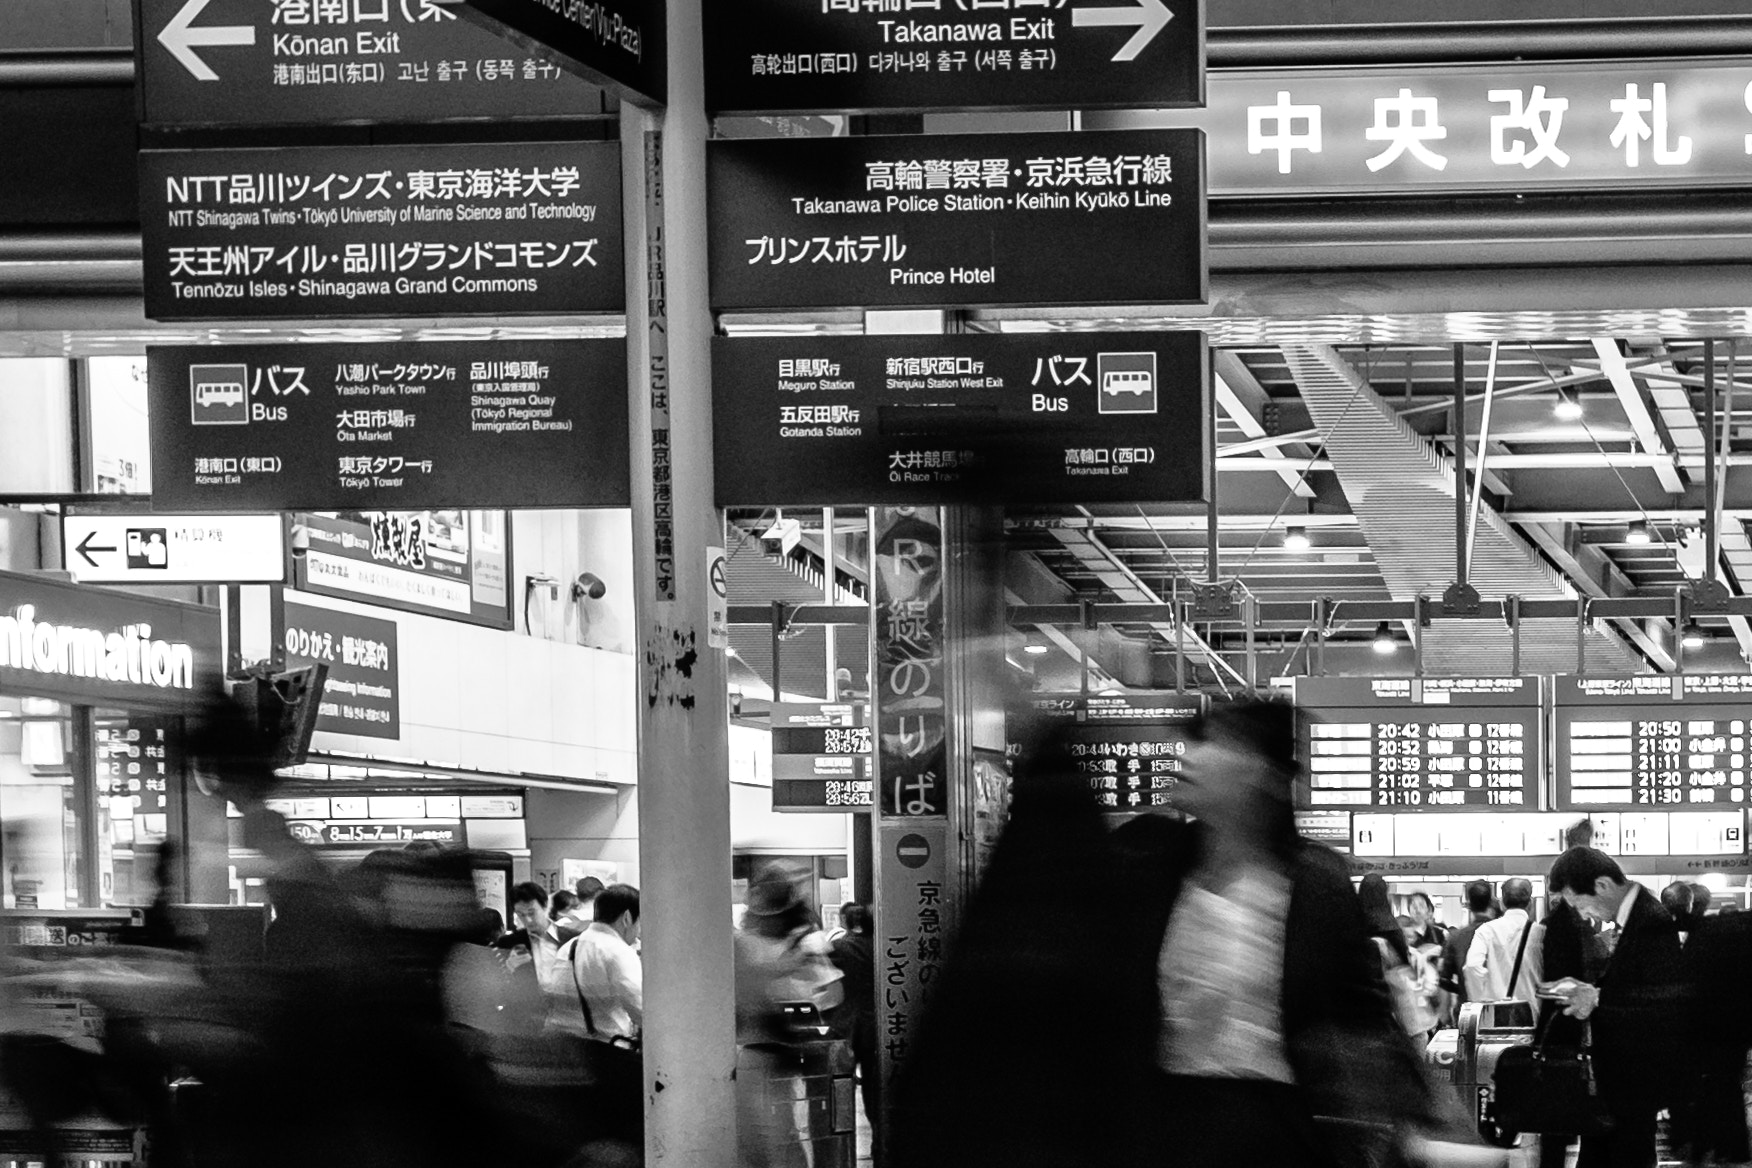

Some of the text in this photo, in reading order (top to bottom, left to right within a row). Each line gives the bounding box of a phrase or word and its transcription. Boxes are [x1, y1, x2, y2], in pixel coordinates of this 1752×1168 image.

[878, 18, 1054, 42] Takanawa Exit
[274, 32, 400, 55] Kōnan Exit
[436, 59, 468, 81] 출구
[869, 51, 931, 73] 다카나와
[937, 51, 968, 72] 출구
[1246, 84, 1693, 174] 中央改札
[865, 155, 1173, 190] 高輪警察署・京浜急行線
[167, 166, 580, 204] NTT品川ツインズ・東京海洋大学
[792, 198, 882, 216] Takanawa
[886, 196, 940, 213] Police
[1074, 191, 1130, 212] Kyūkō
[1134, 191, 1172, 208] Line
[169, 211, 193, 226] NTT
[197, 209, 259, 229] Shinagawa
[341, 205, 397, 225] University
[399, 205, 411, 222] of
[414, 207, 451, 222] Marine
[456, 204, 501, 220] Science
[505, 204, 526, 219] and
[529, 202, 596, 222] Technology
[746, 235, 906, 264] プリンスホテル
[890, 267, 995, 285] Prince Hotel
[172, 281, 244, 299] Tennōzu
[395, 278, 447, 294] Grand
[451, 276, 538, 293] Commons
[335, 363, 456, 382] 八潮パークタウン行
[470, 361, 549, 380] 品川埠頭行
[778, 359, 841, 378] 目黒駅行
[886, 357, 984, 376] 新宿駅西口行
[1031, 355, 1092, 387] バス
[251, 366, 311, 396] バス
[335, 383, 426, 397] Yashio Park Town
[778, 379, 856, 392] Meguro Station
[886, 376, 1004, 390] Shinjuku Station West Exit
[471, 394, 556, 408] Shinagawa Quay
[1031, 394, 1069, 412] Bus
[252, 403, 288, 421] Bus
[336, 409, 416, 429] 大田市場行
[508, 407, 552, 420] Regional
[779, 405, 860, 424] 五反田駅行
[357, 429, 393, 441] Market
[472, 420, 530, 433] Immigration
[779, 425, 862, 439] Gotanda Station
[194, 456, 282, 473] 港南口(東口)
[338, 455, 433, 474] 東京タワー行
[373, 474, 403, 488] Tower
[904, 471, 930, 481] Race
[1378, 723, 1421, 738] 20:42
[1638, 721, 1682, 736] 20:50
[1378, 740, 1421, 755] 20:52
[1638, 737, 1682, 753] 21:00
[1378, 757, 1421, 772] 20:59
[1638, 754, 1682, 770] 21:11
[1378, 774, 1421, 789] 21:02
[1638, 771, 1682, 787] 21:20
[1378, 790, 1421, 805] 21:10
[1638, 788, 1682, 804] 21:30
